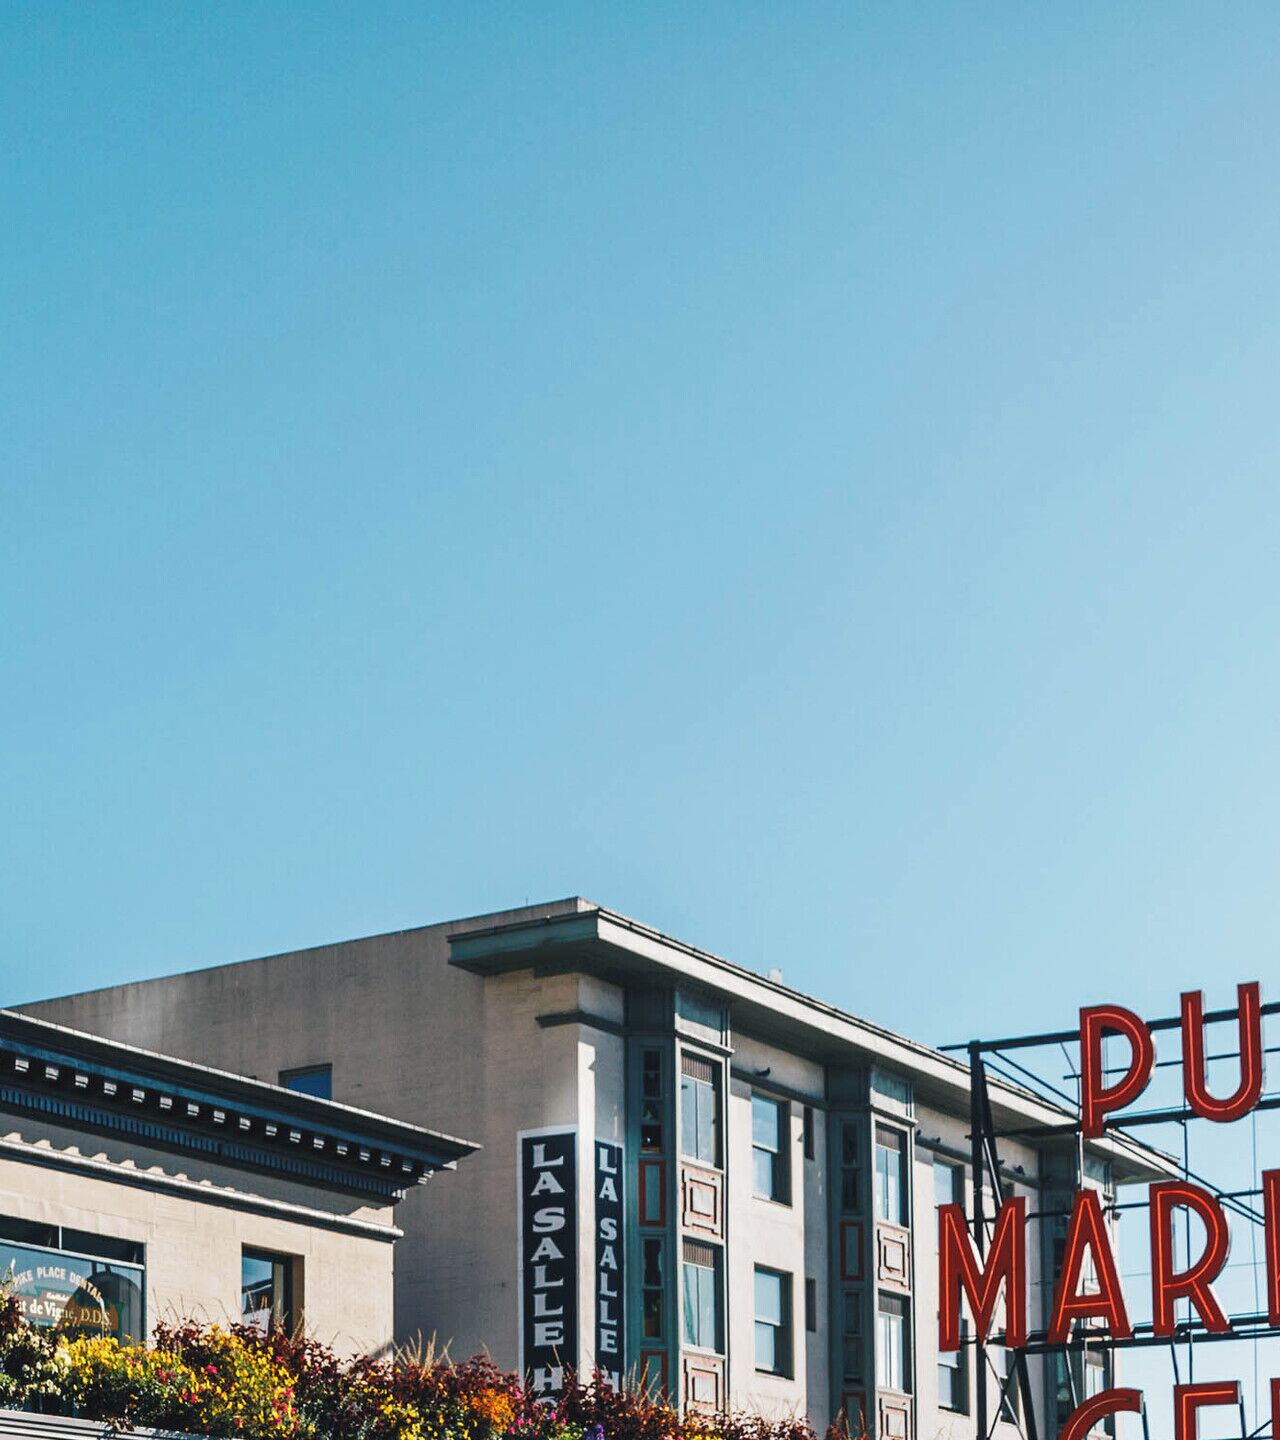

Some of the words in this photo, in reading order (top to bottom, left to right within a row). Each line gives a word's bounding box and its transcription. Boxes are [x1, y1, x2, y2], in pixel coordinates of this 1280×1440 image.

[531, 1144, 565, 1196] LA
[599, 1147, 618, 1202] LA
[37, 1267, 66, 1281] PLACE
[69, 1272, 103, 1304] DENTAL
[531, 1207, 566, 1347] SALLE
[599, 1217, 618, 1354] SALLE
[30, 1298, 43, 1314] de
